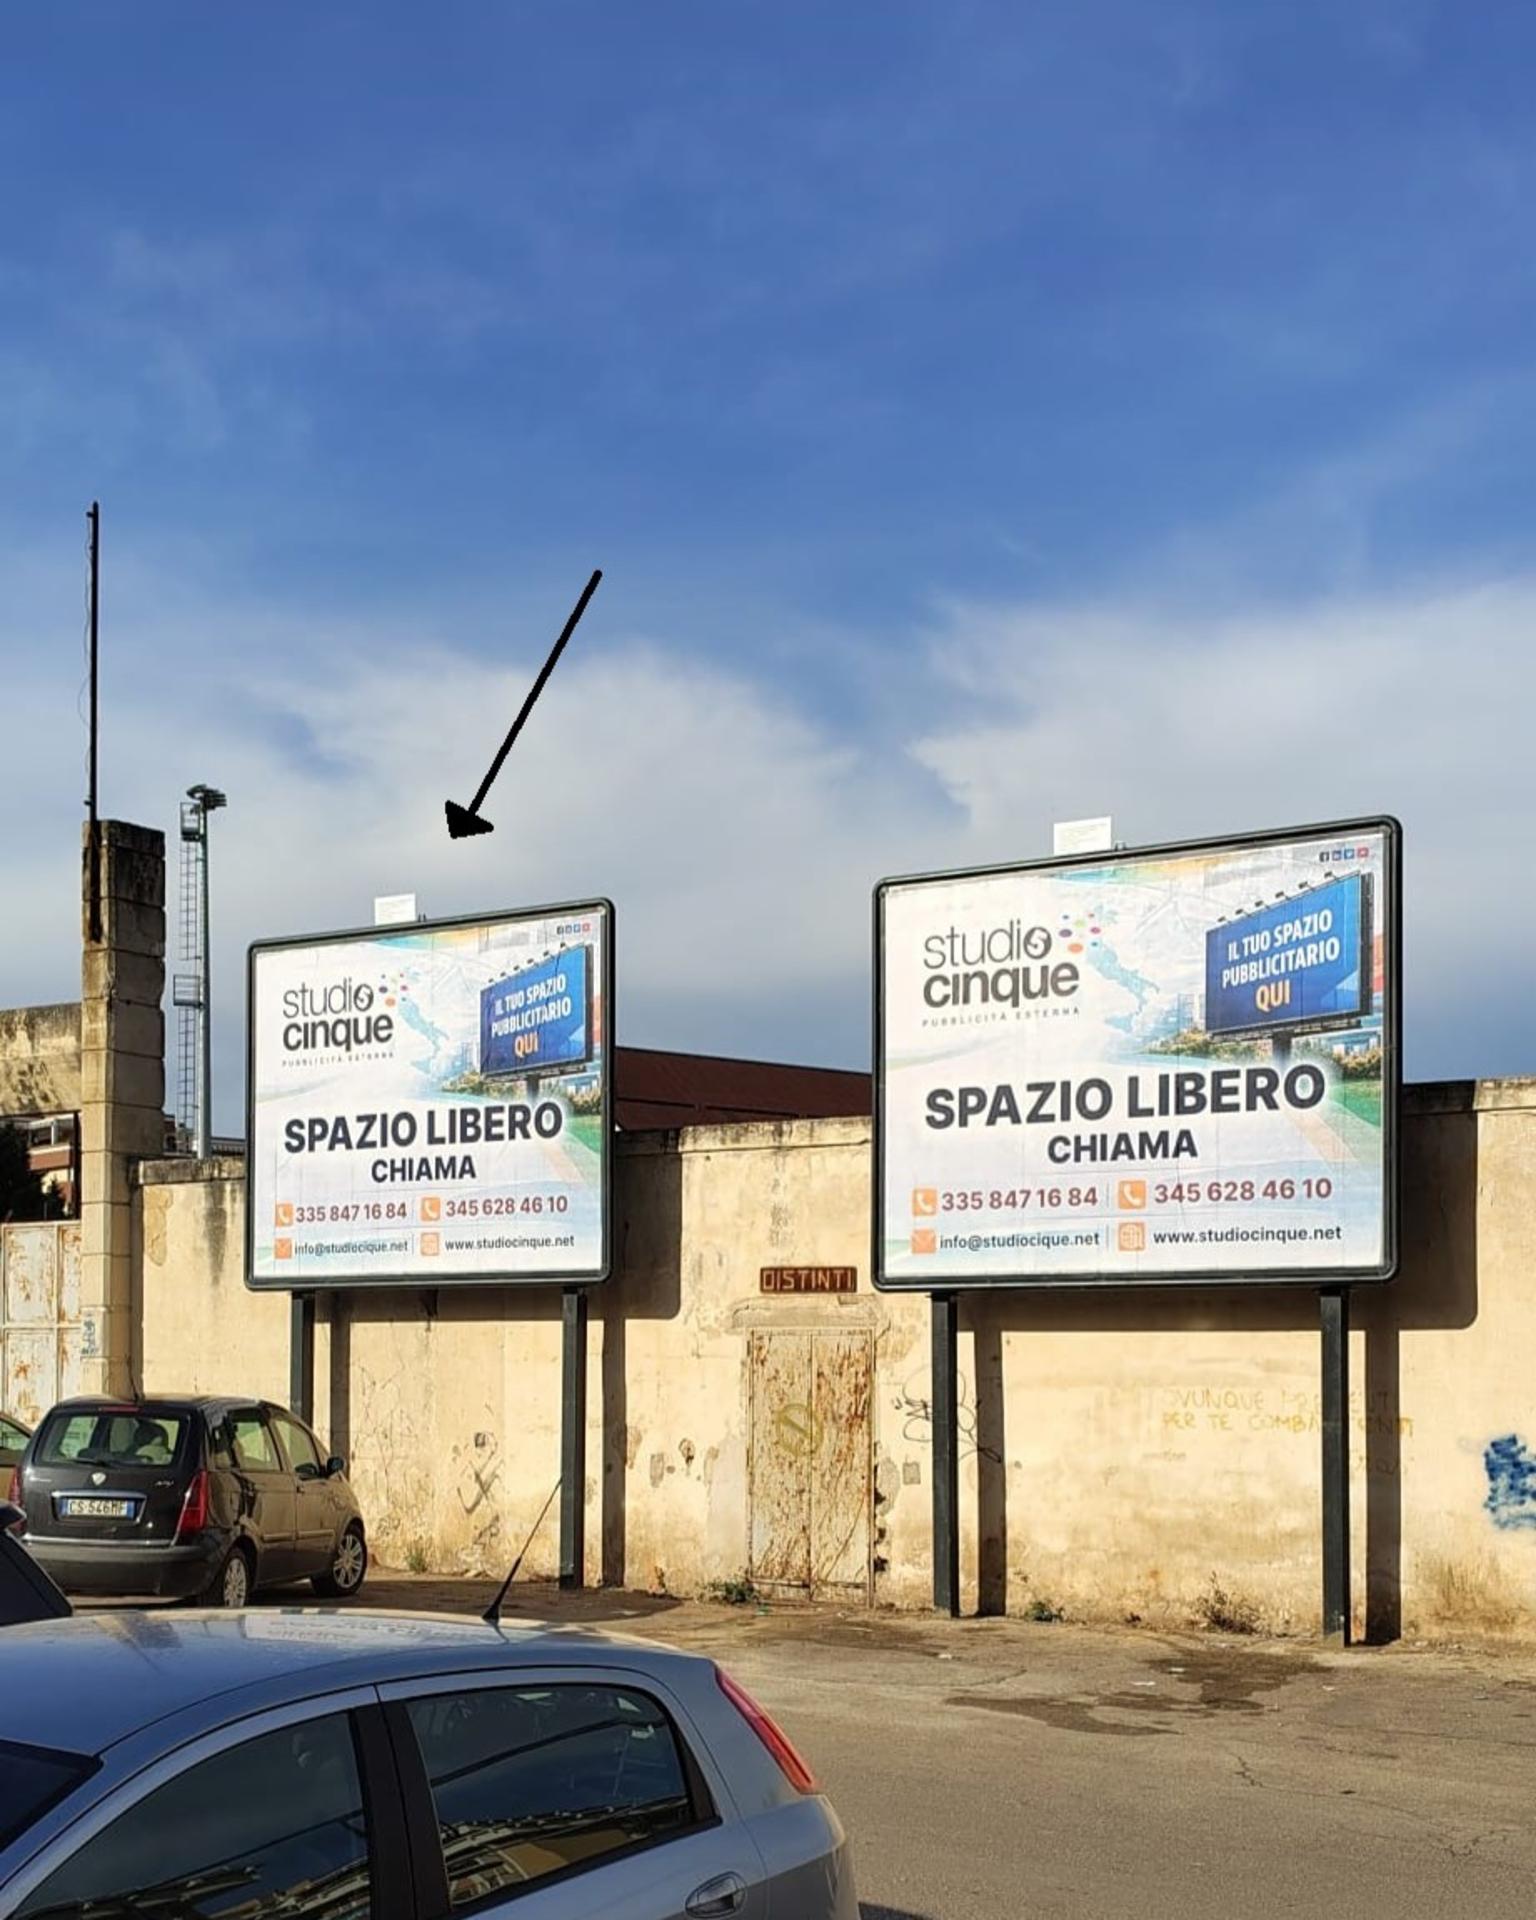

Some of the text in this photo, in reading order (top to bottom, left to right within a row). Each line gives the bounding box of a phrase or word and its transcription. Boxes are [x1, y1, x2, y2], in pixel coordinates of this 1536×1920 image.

[923, 918, 1053, 969] studio
[1228, 908, 1333, 962] IL TUO SPAZIO
[1222, 936, 1340, 989] PUBBLICITARIO
[283, 977, 375, 1019] studio
[495, 973, 567, 1016] IL TUO SPAZIO
[923, 962, 1080, 1008] cinque
[1255, 978, 1291, 1012] QUI
[283, 1014, 394, 1052] cinque
[491, 996, 572, 1039] PUBBLICITARIO
[514, 1031, 539, 1058] QUI
[925, 1064, 1325, 1130] SPAZIO LIBERO
[284, 1101, 563, 1154] SPAZIO LIBERO
[1047, 1129, 1199, 1164] CHIAMA
[371, 1155, 477, 1183] CHIAMA
[446, 1195, 568, 1217] 345 628 46 10
[941, 1187, 1098, 1211] 335 847 16 84
[1154, 1178, 1332, 1204] 345 628 46 10
[296, 1202, 407, 1222] 335 847 16 84
[445, 1234, 575, 1251] www.studiocinque.net
[940, 1232, 1100, 1251] info@studiocique.net
[1153, 1225, 1342, 1244] www.studiocinque.net
[1210, 1413, 1233, 1431] TE
